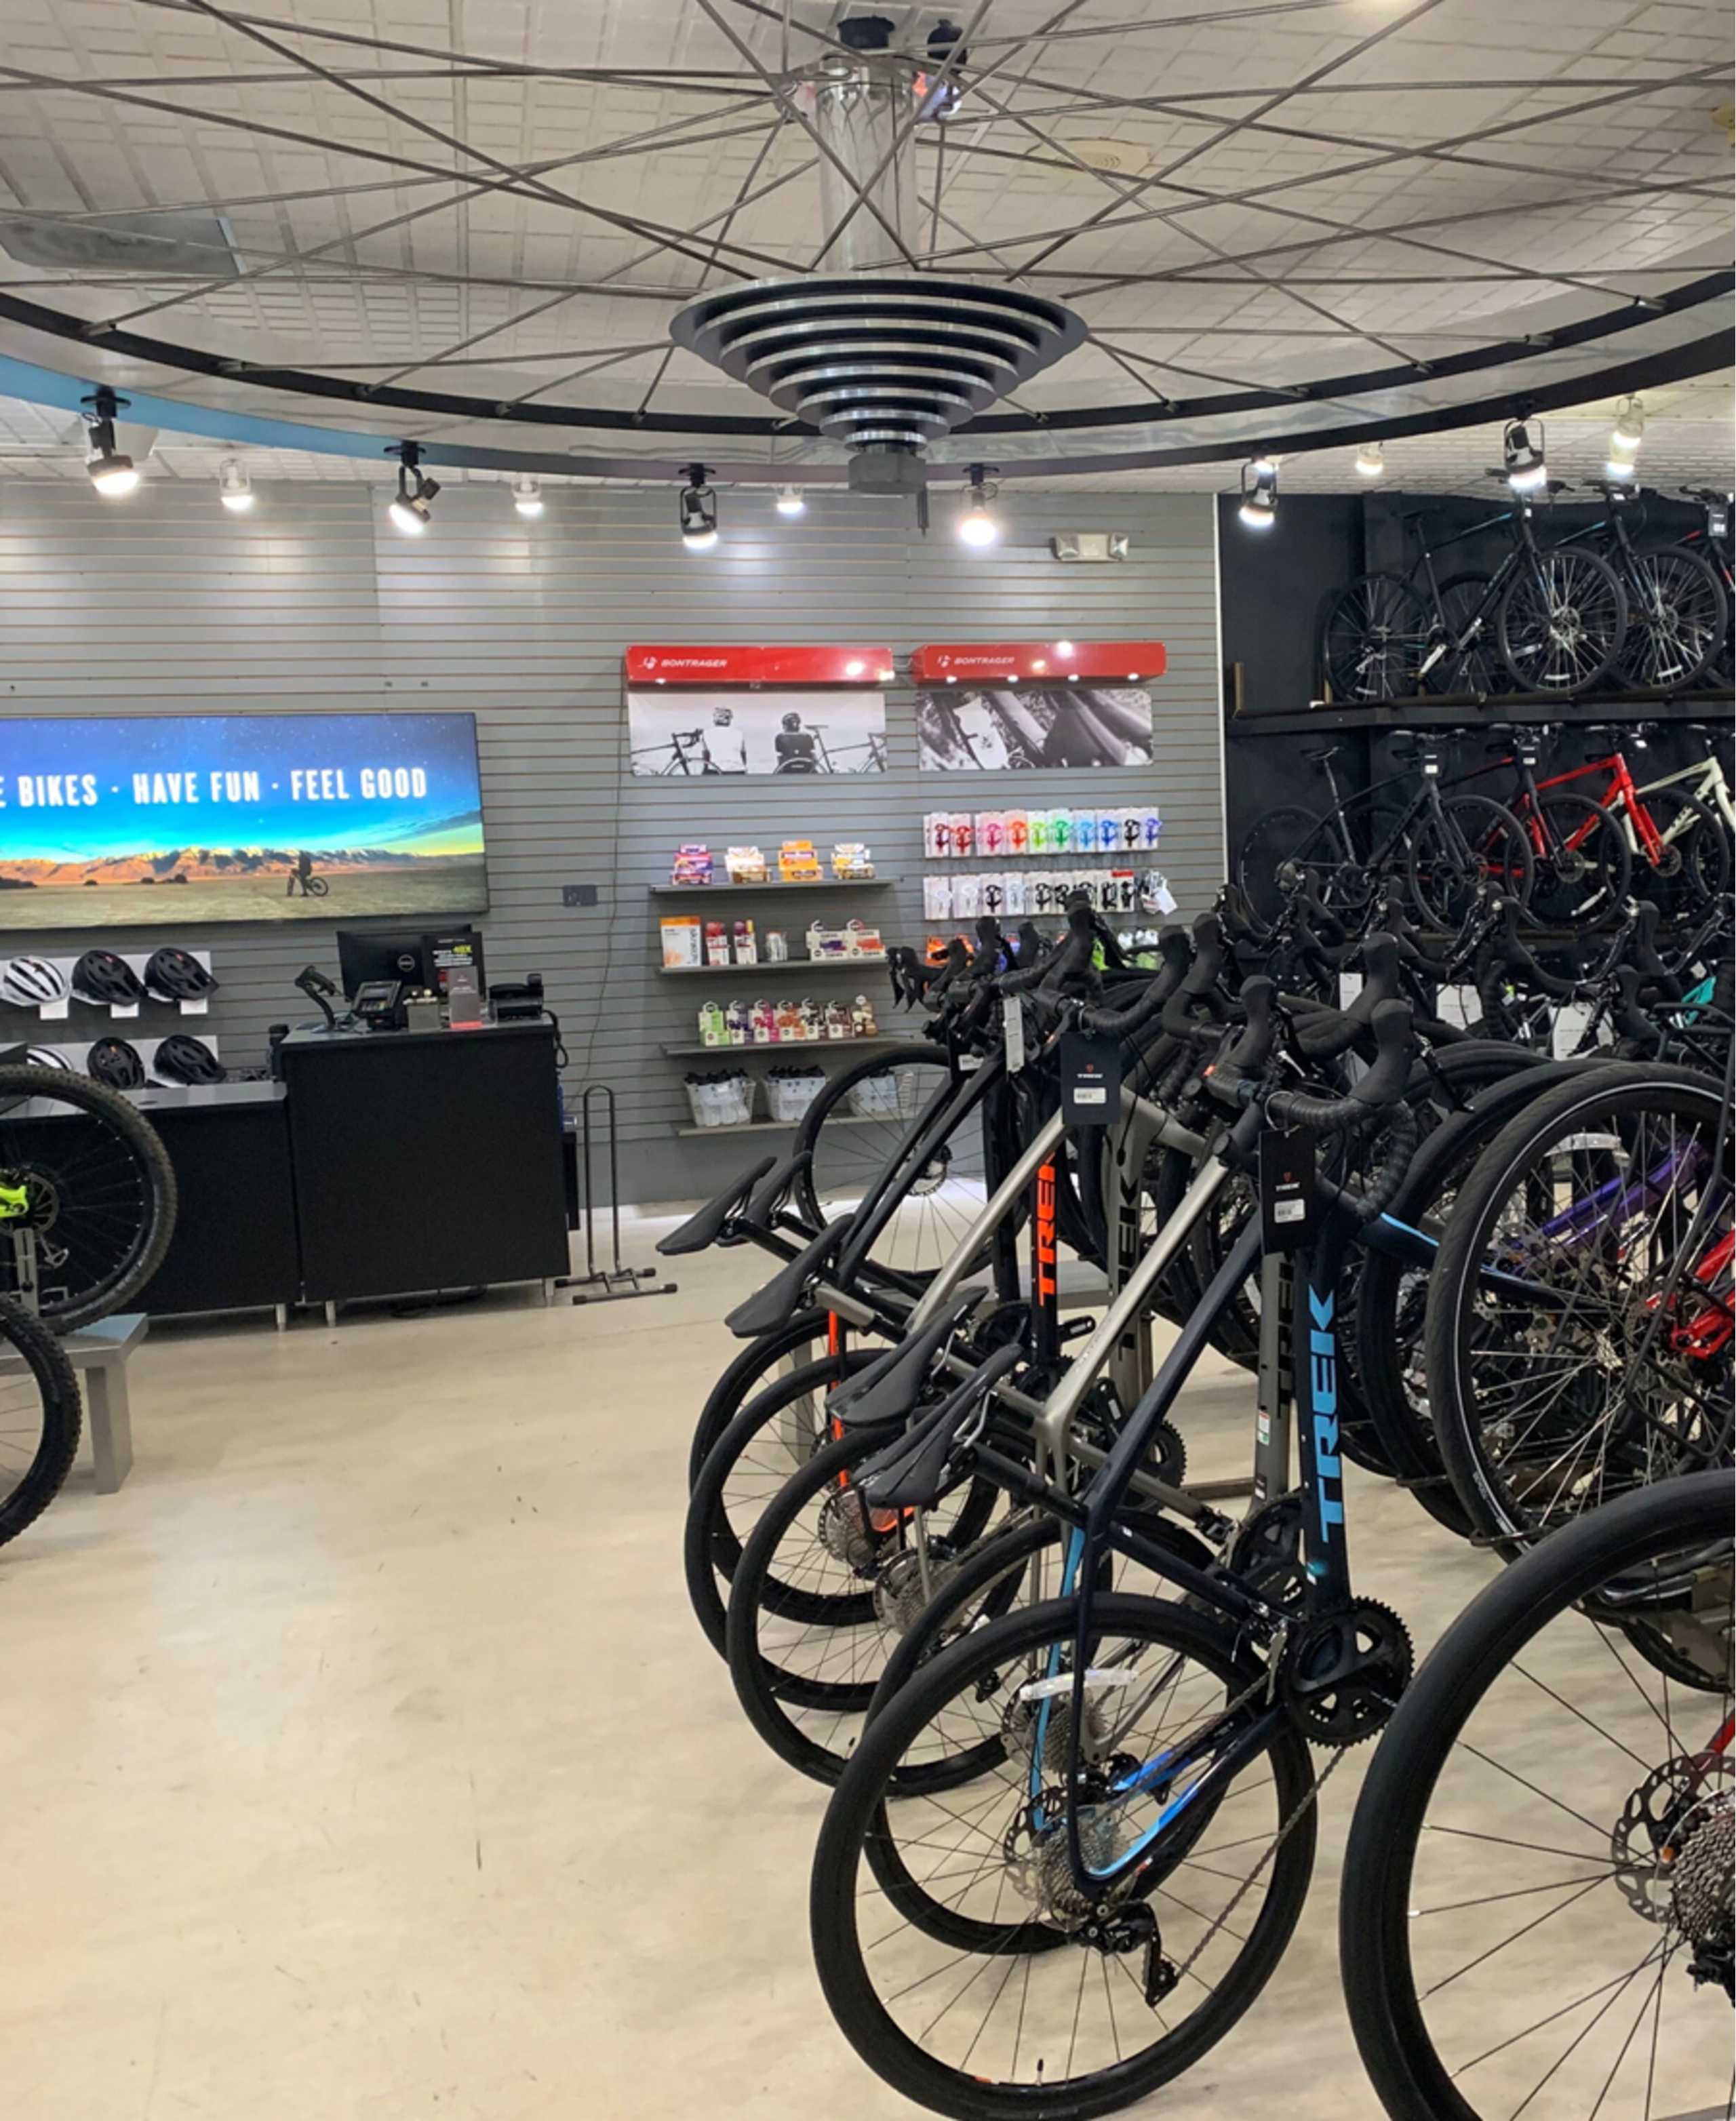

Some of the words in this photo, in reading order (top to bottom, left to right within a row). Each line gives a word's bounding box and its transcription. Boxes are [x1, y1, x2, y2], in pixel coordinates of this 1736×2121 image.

[660, 658, 728, 668] BONTRAGER
[954, 656, 1015, 665] BONTRAGER
[18, 774, 98, 808] BIKES
[132, 771, 200, 805] HAVE
[210, 770, 260, 803] FUN
[290, 768, 350, 801] FEEL
[359, 767, 427, 799] GOOD
[1308, 1284, 1344, 1543] TREK
